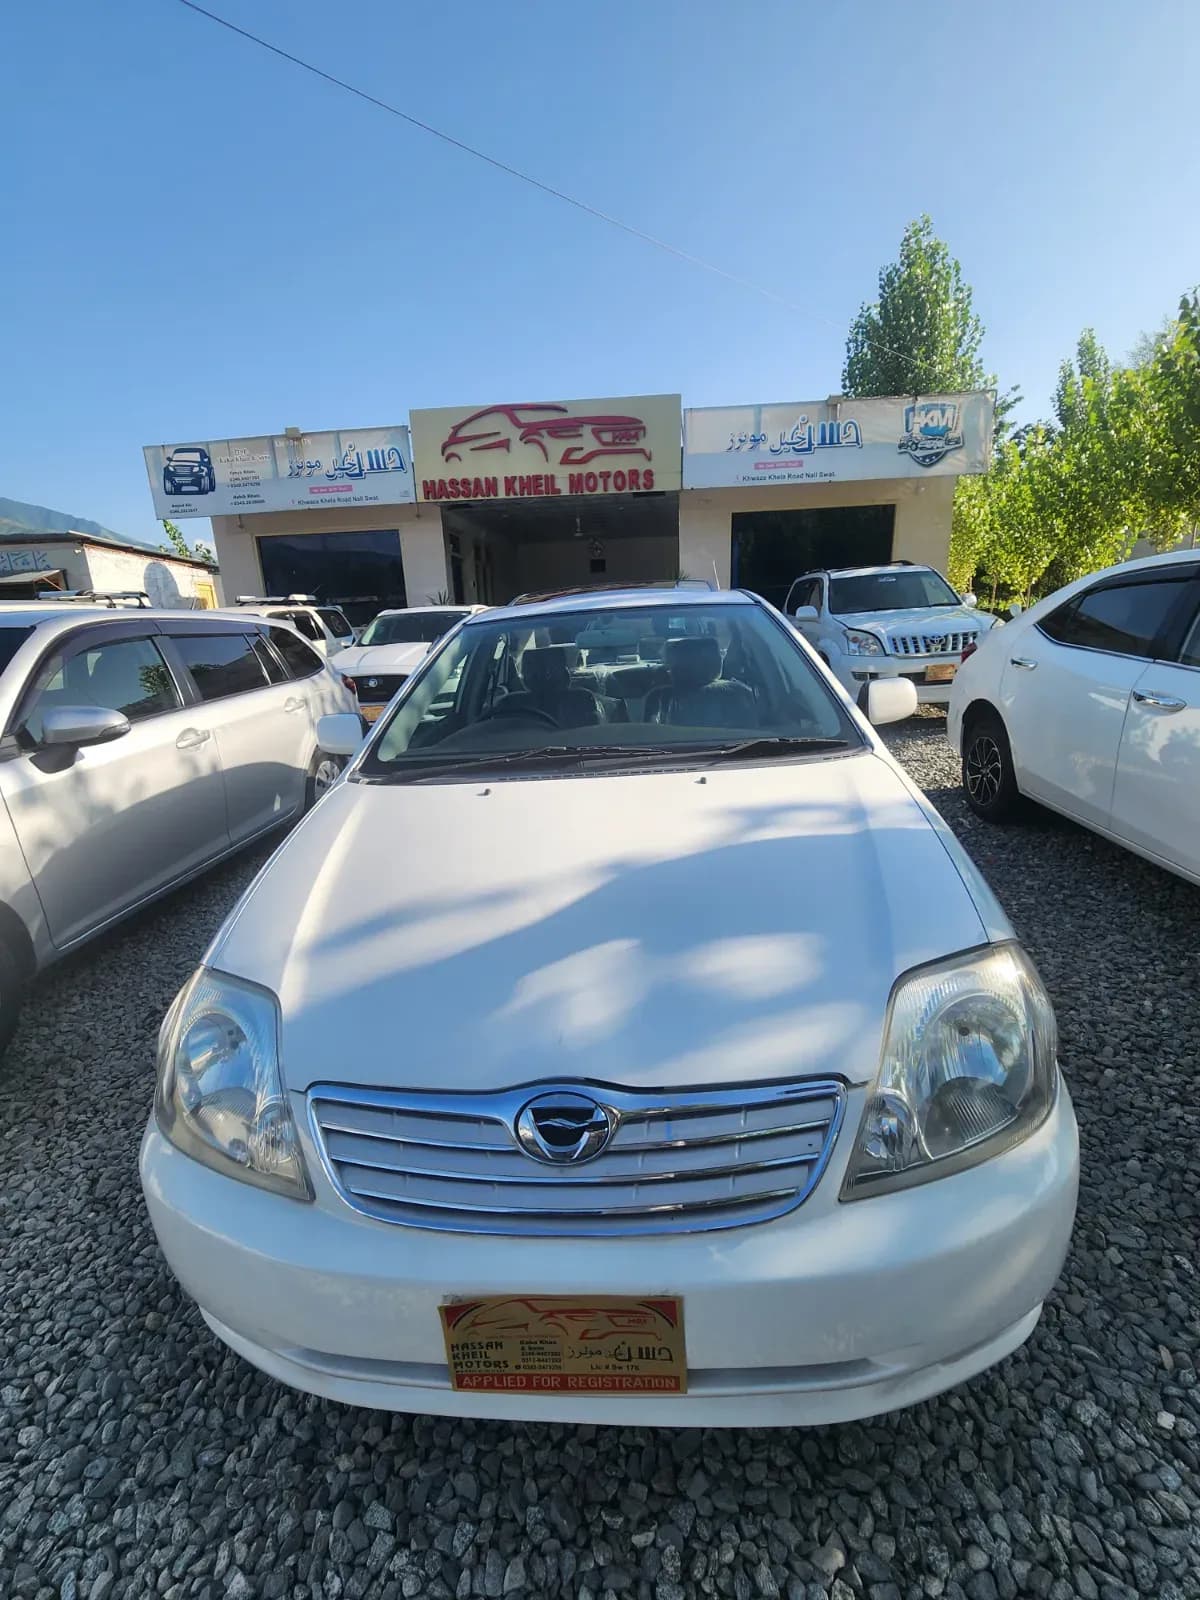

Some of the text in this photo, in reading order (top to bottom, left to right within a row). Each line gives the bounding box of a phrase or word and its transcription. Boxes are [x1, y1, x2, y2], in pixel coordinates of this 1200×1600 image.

[422, 469, 654, 500] HASSAN KHEIL MOTORS
[451, 1341, 503, 1353] HASSAN
[453, 1351, 490, 1361] KHEIL
[453, 1360, 509, 1370] MOTORS
[462, 1375, 676, 1389] APPLIED FOR REGISTRATION
